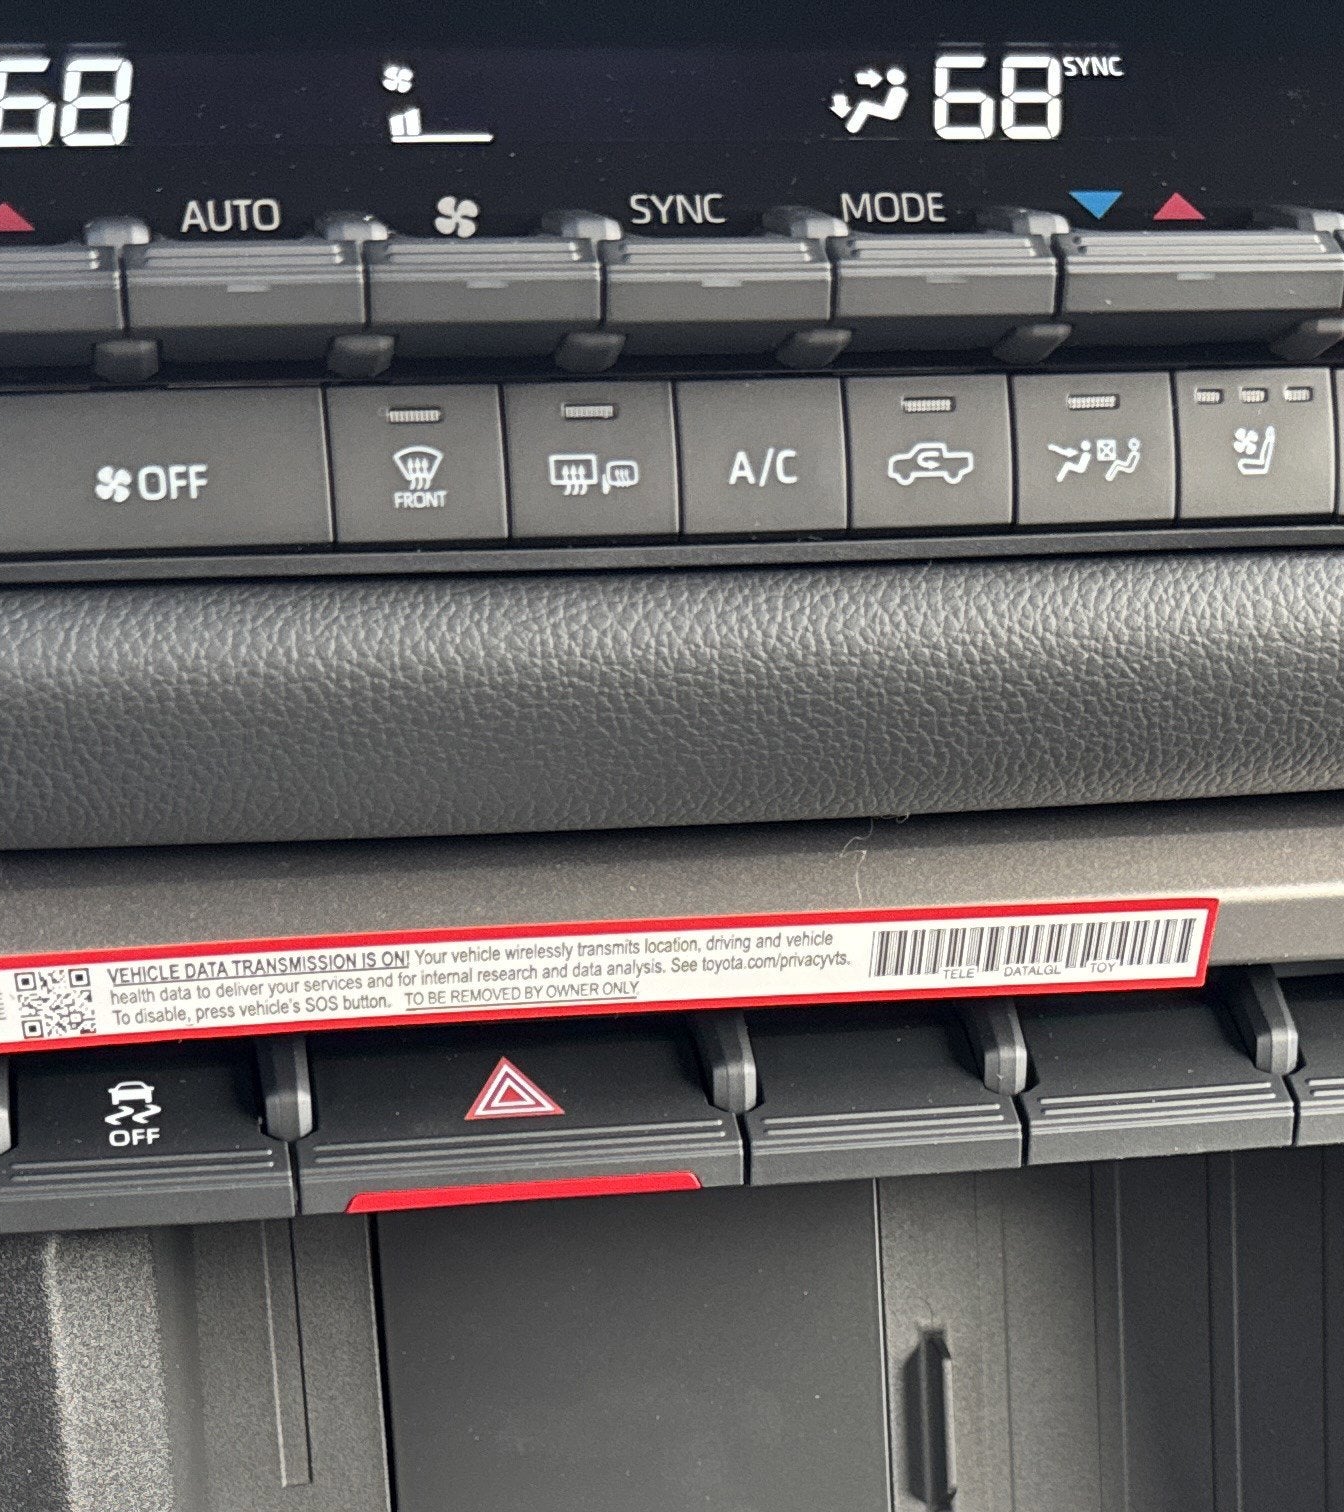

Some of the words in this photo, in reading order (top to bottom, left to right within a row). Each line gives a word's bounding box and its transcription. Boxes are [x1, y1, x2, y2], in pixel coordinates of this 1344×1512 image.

[932, 56, 1062, 140] 68
[1063, 54, 1124, 79] SYNC
[181, 198, 280, 232] AUTO
[630, 193, 728, 225] SYNC
[840, 191, 945, 224] MODE
[137, 464, 208, 501] OFF
[728, 450, 798, 487] A/C
[393, 490, 447, 509] FRONT
[107, 964, 180, 983] VEHICLE
[184, 961, 228, 979] DATA
[232, 953, 356, 976] TRANSMISSION
[361, 952, 376, 968] IS
[381, 950, 409, 967] ON!
[414, 949, 445, 964] Your
[451, 946, 499, 962] vehicle
[505, 942, 572, 961] wirelessly
[577, 939, 639, 956] transmits
[644, 937, 701, 954] location,
[706, 934, 750, 953] driving
[756, 932, 781, 948] and
[786, 930, 832, 947] vehicle
[942, 968, 974, 979] TELE
[1089, 961, 1116, 973] TOY
[110, 988, 155, 1004] health
[159, 986, 191, 1001] data
[196, 984, 210, 999] to
[216, 981, 263, 997] deliver
[268, 981, 299, 997] your
[304, 977, 362, 992] services
[367, 973, 393, 988] and
[397, 972, 416, 986] for
[421, 968, 472, 985] internal
[477, 965, 536, 982] research
[542, 963, 567, 978] and
[572, 962, 601, 977] data
[607, 959, 665, 978] analysis.
[671, 957, 697, 972] See
[112, 1009, 130, 1024] To
[134, 1005, 191, 1024] disable,
[195, 1005, 234, 1022] press
[239, 998, 300, 1016] vehicle's
[305, 995, 338, 1012] SOS
[343, 993, 391, 1010] button.
[405, 992, 423, 1005] TO
[428, 990, 445, 1004] BE
[451, 986, 520, 1002] REMOVED
[525, 985, 542, 999] BY
[546, 982, 598, 997] OWNER
[108, 1126, 161, 1148] OFF
